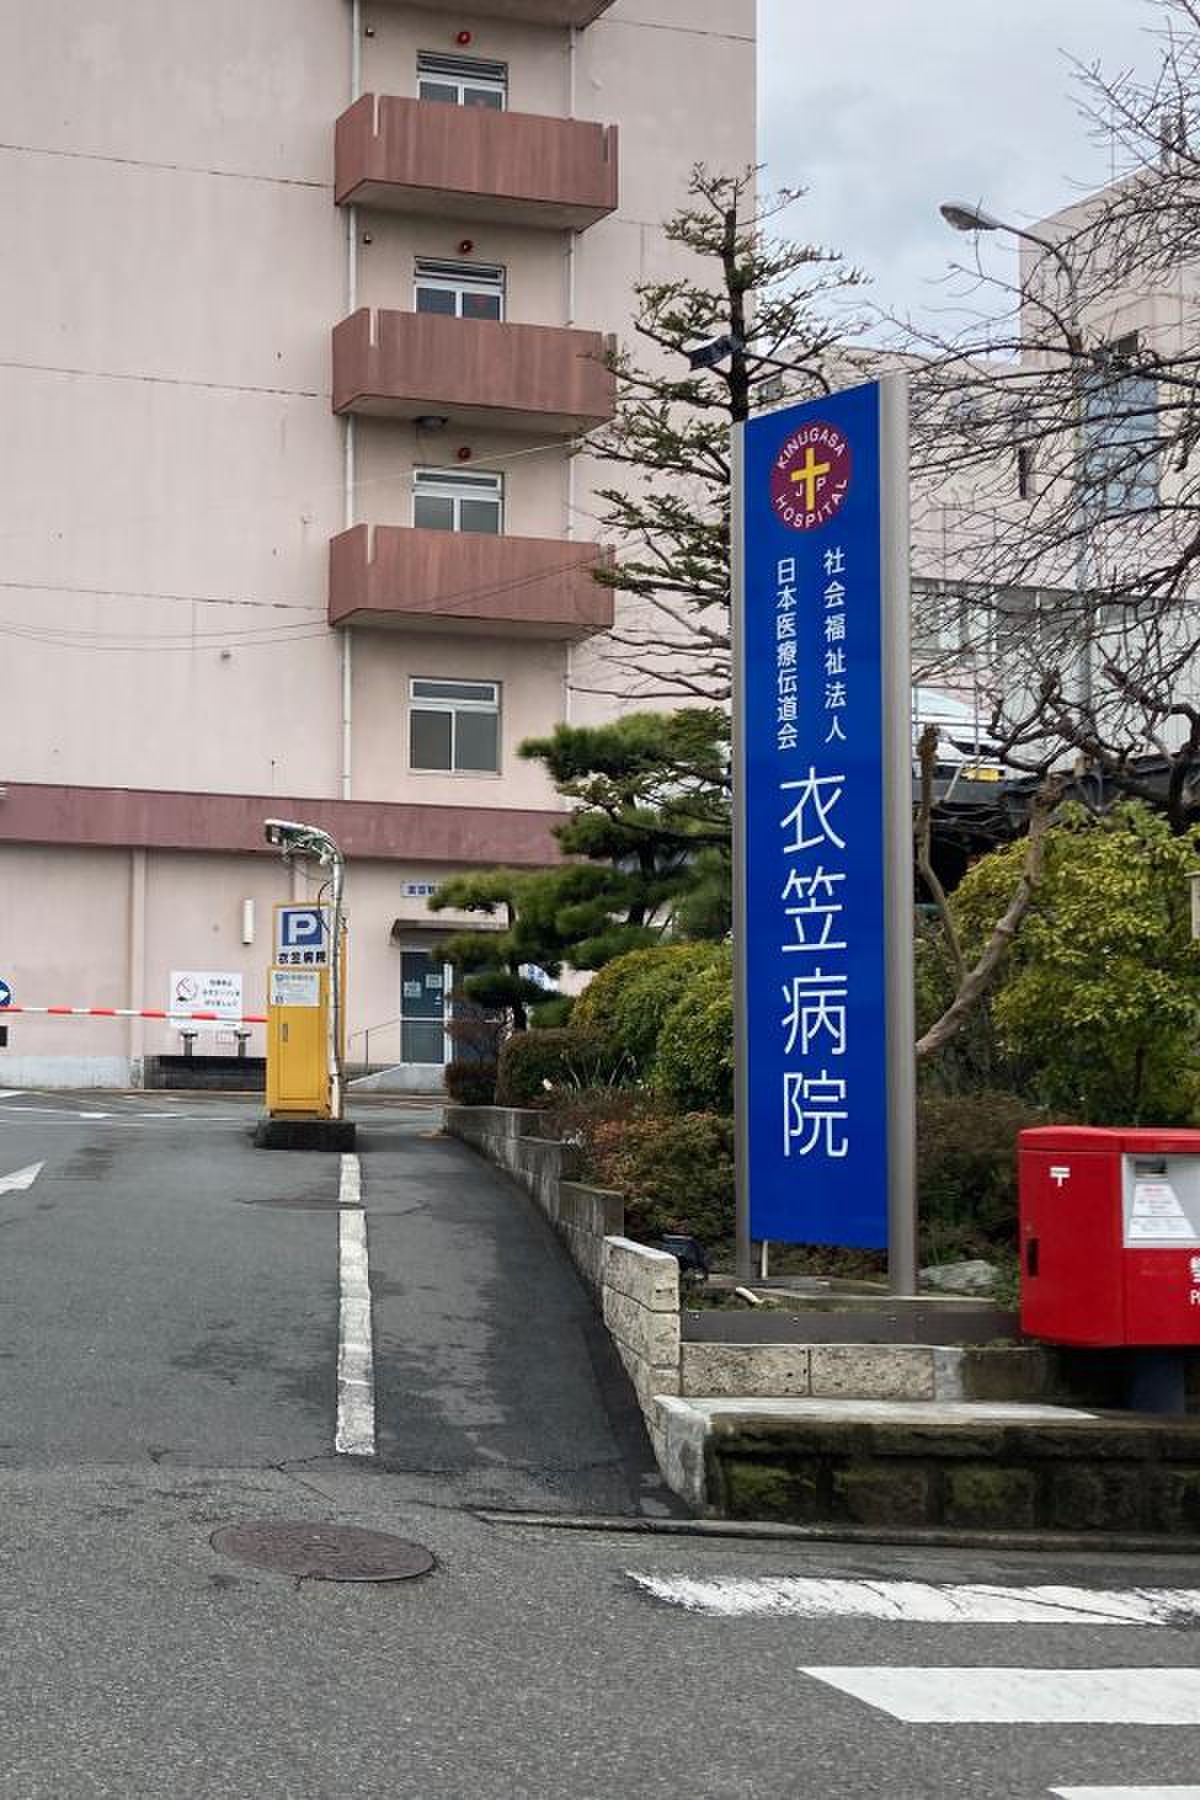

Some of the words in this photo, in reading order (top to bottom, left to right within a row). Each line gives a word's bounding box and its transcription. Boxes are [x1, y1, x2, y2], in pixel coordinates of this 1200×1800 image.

[777, 427, 846, 470] KINUGASA
[776, 479, 847, 528] HOSPITAL
[795, 483, 803, 496] J
[816, 477, 826, 491] P
[776, 557, 798, 750] 日本医療伝道会
[824, 546, 847, 743] 社会福祉法人
[287, 913, 318, 944] P
[779, 766, 850, 1158] 衣笠病院
